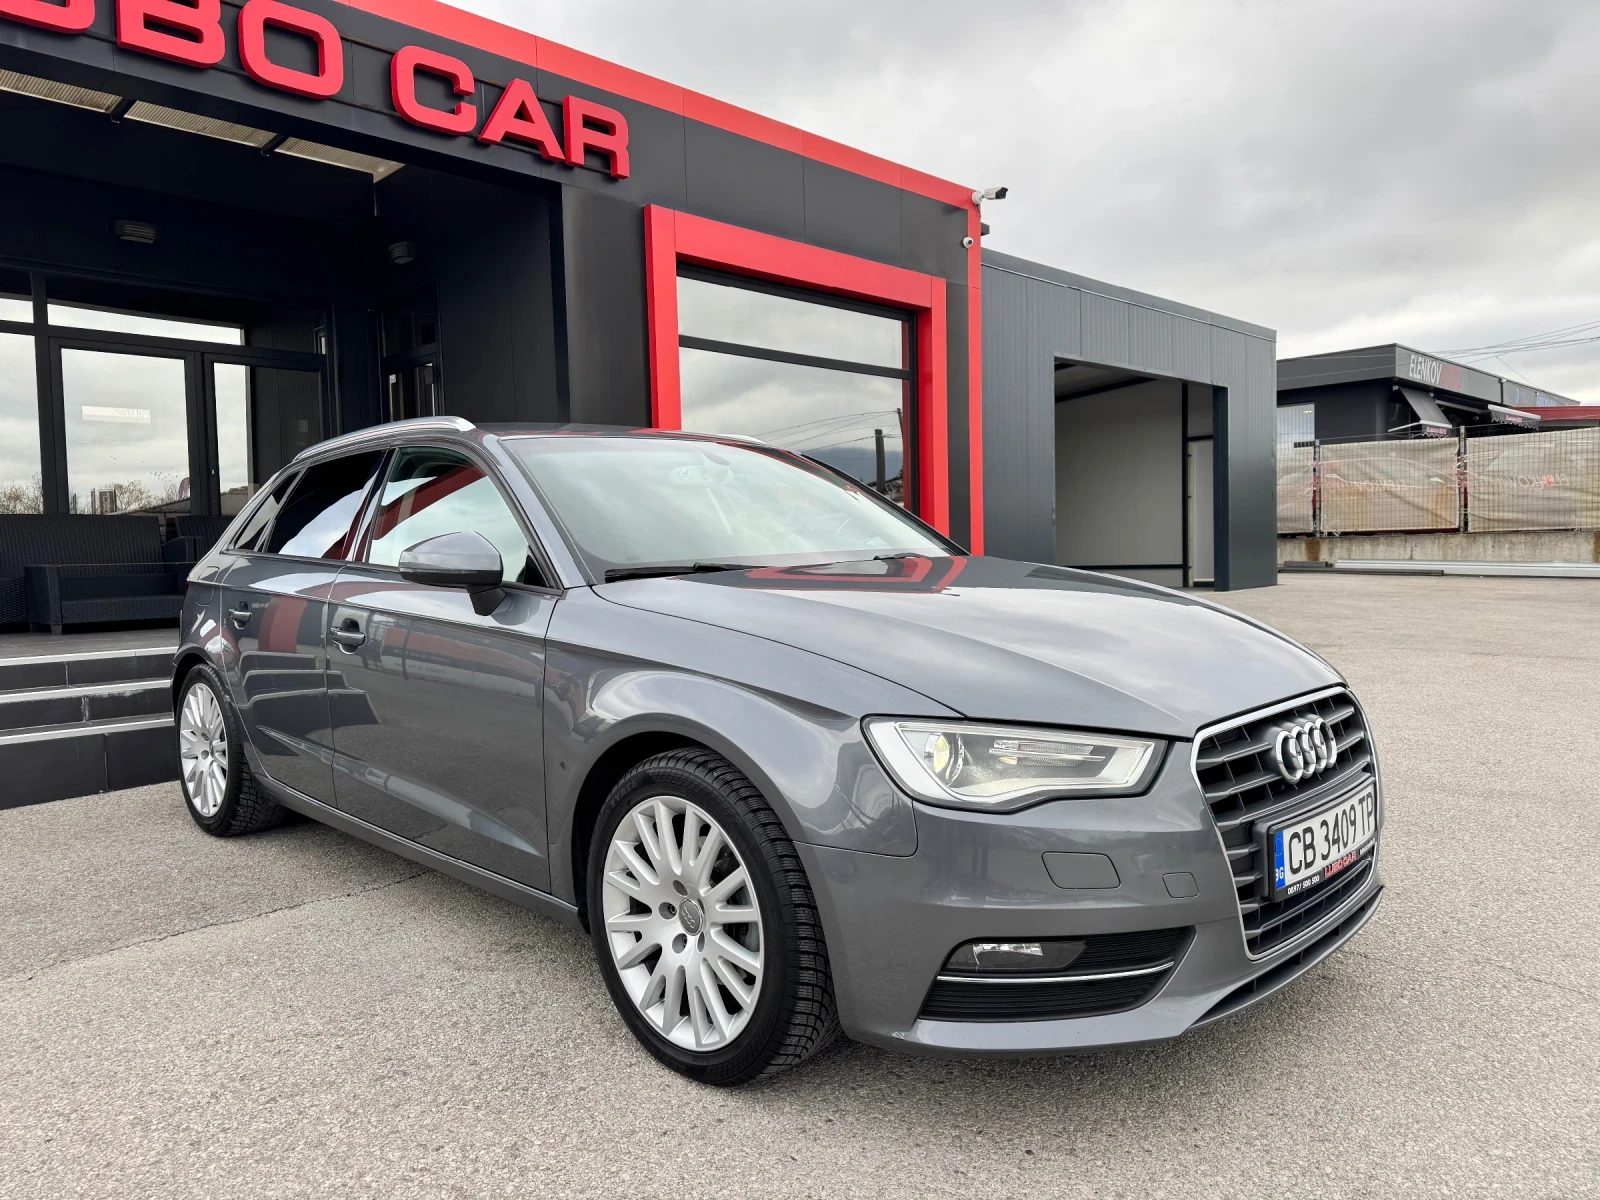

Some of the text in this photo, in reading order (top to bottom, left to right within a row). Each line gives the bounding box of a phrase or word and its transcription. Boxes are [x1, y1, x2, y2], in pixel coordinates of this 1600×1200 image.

[390, 45, 631, 179] CAR
[1409, 354, 1442, 384] ELENKOV
[1288, 791, 1374, 875] CB 3409 TP
